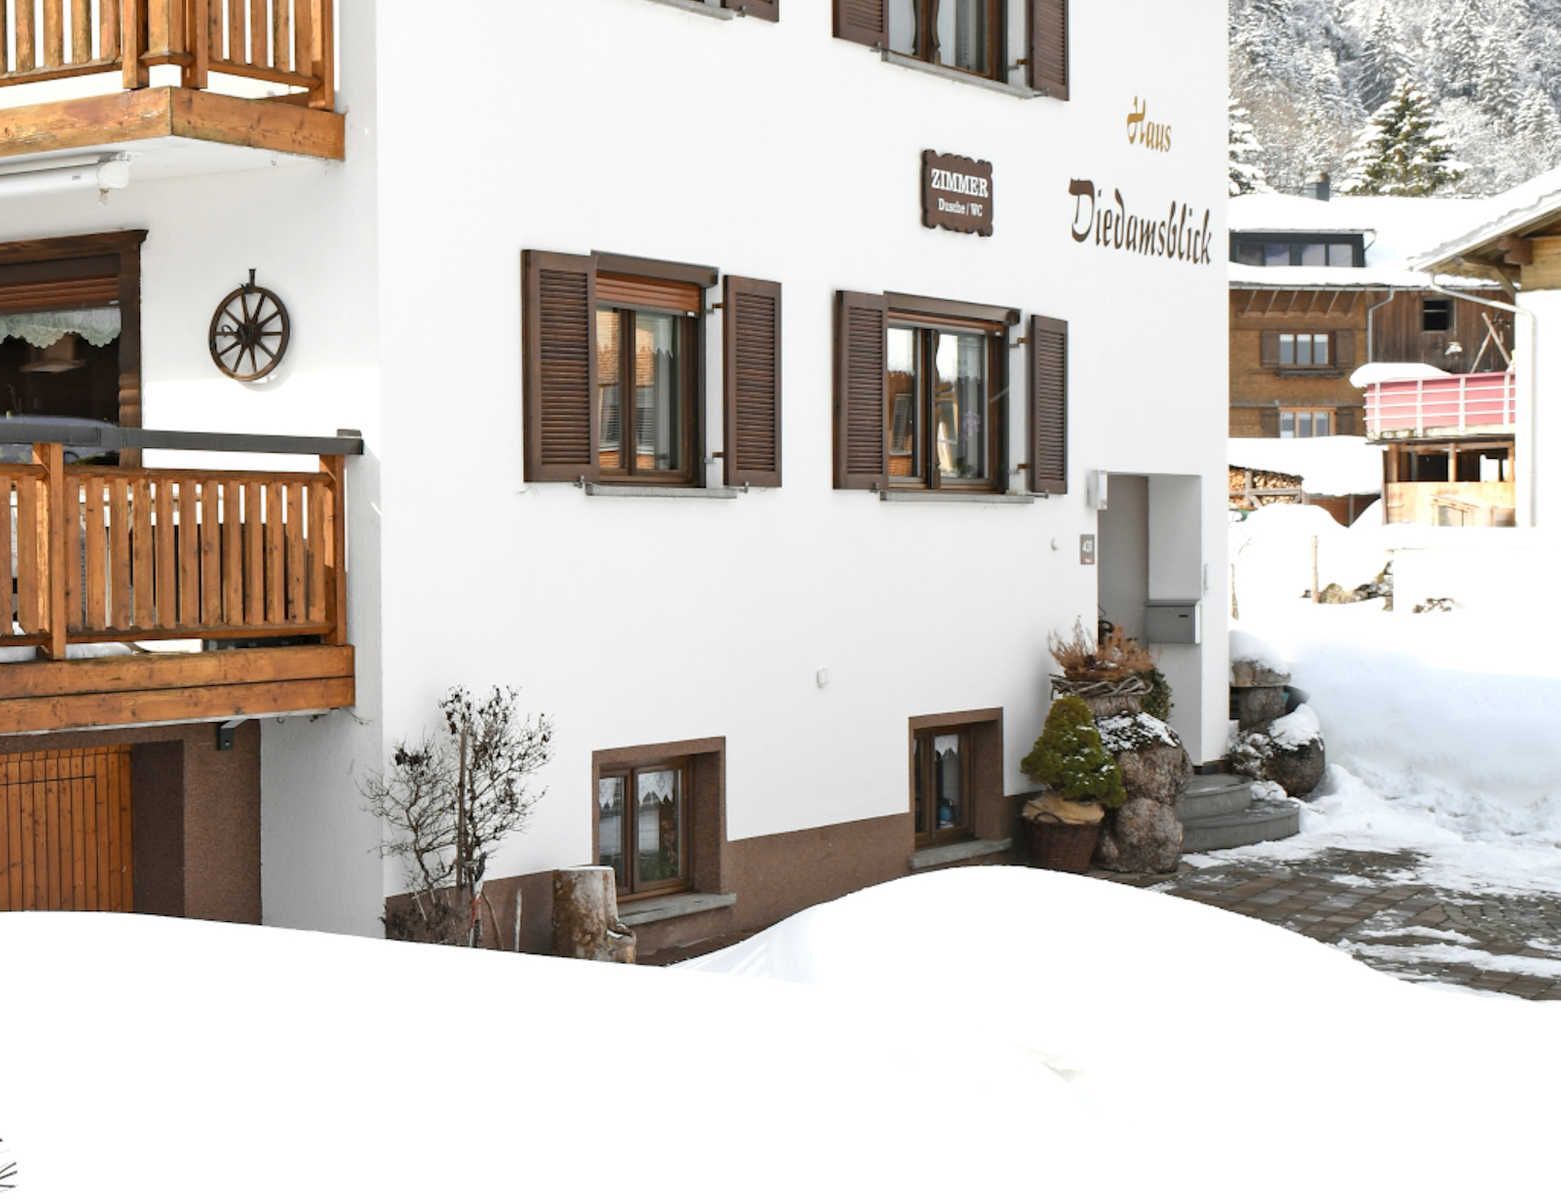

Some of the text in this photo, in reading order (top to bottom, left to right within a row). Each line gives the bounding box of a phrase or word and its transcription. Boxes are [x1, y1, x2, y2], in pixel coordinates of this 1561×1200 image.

[1126, 95, 1172, 153] Haus
[931, 167, 989, 198] ZIMMER
[1068, 177, 1212, 265] Diedamsblick
